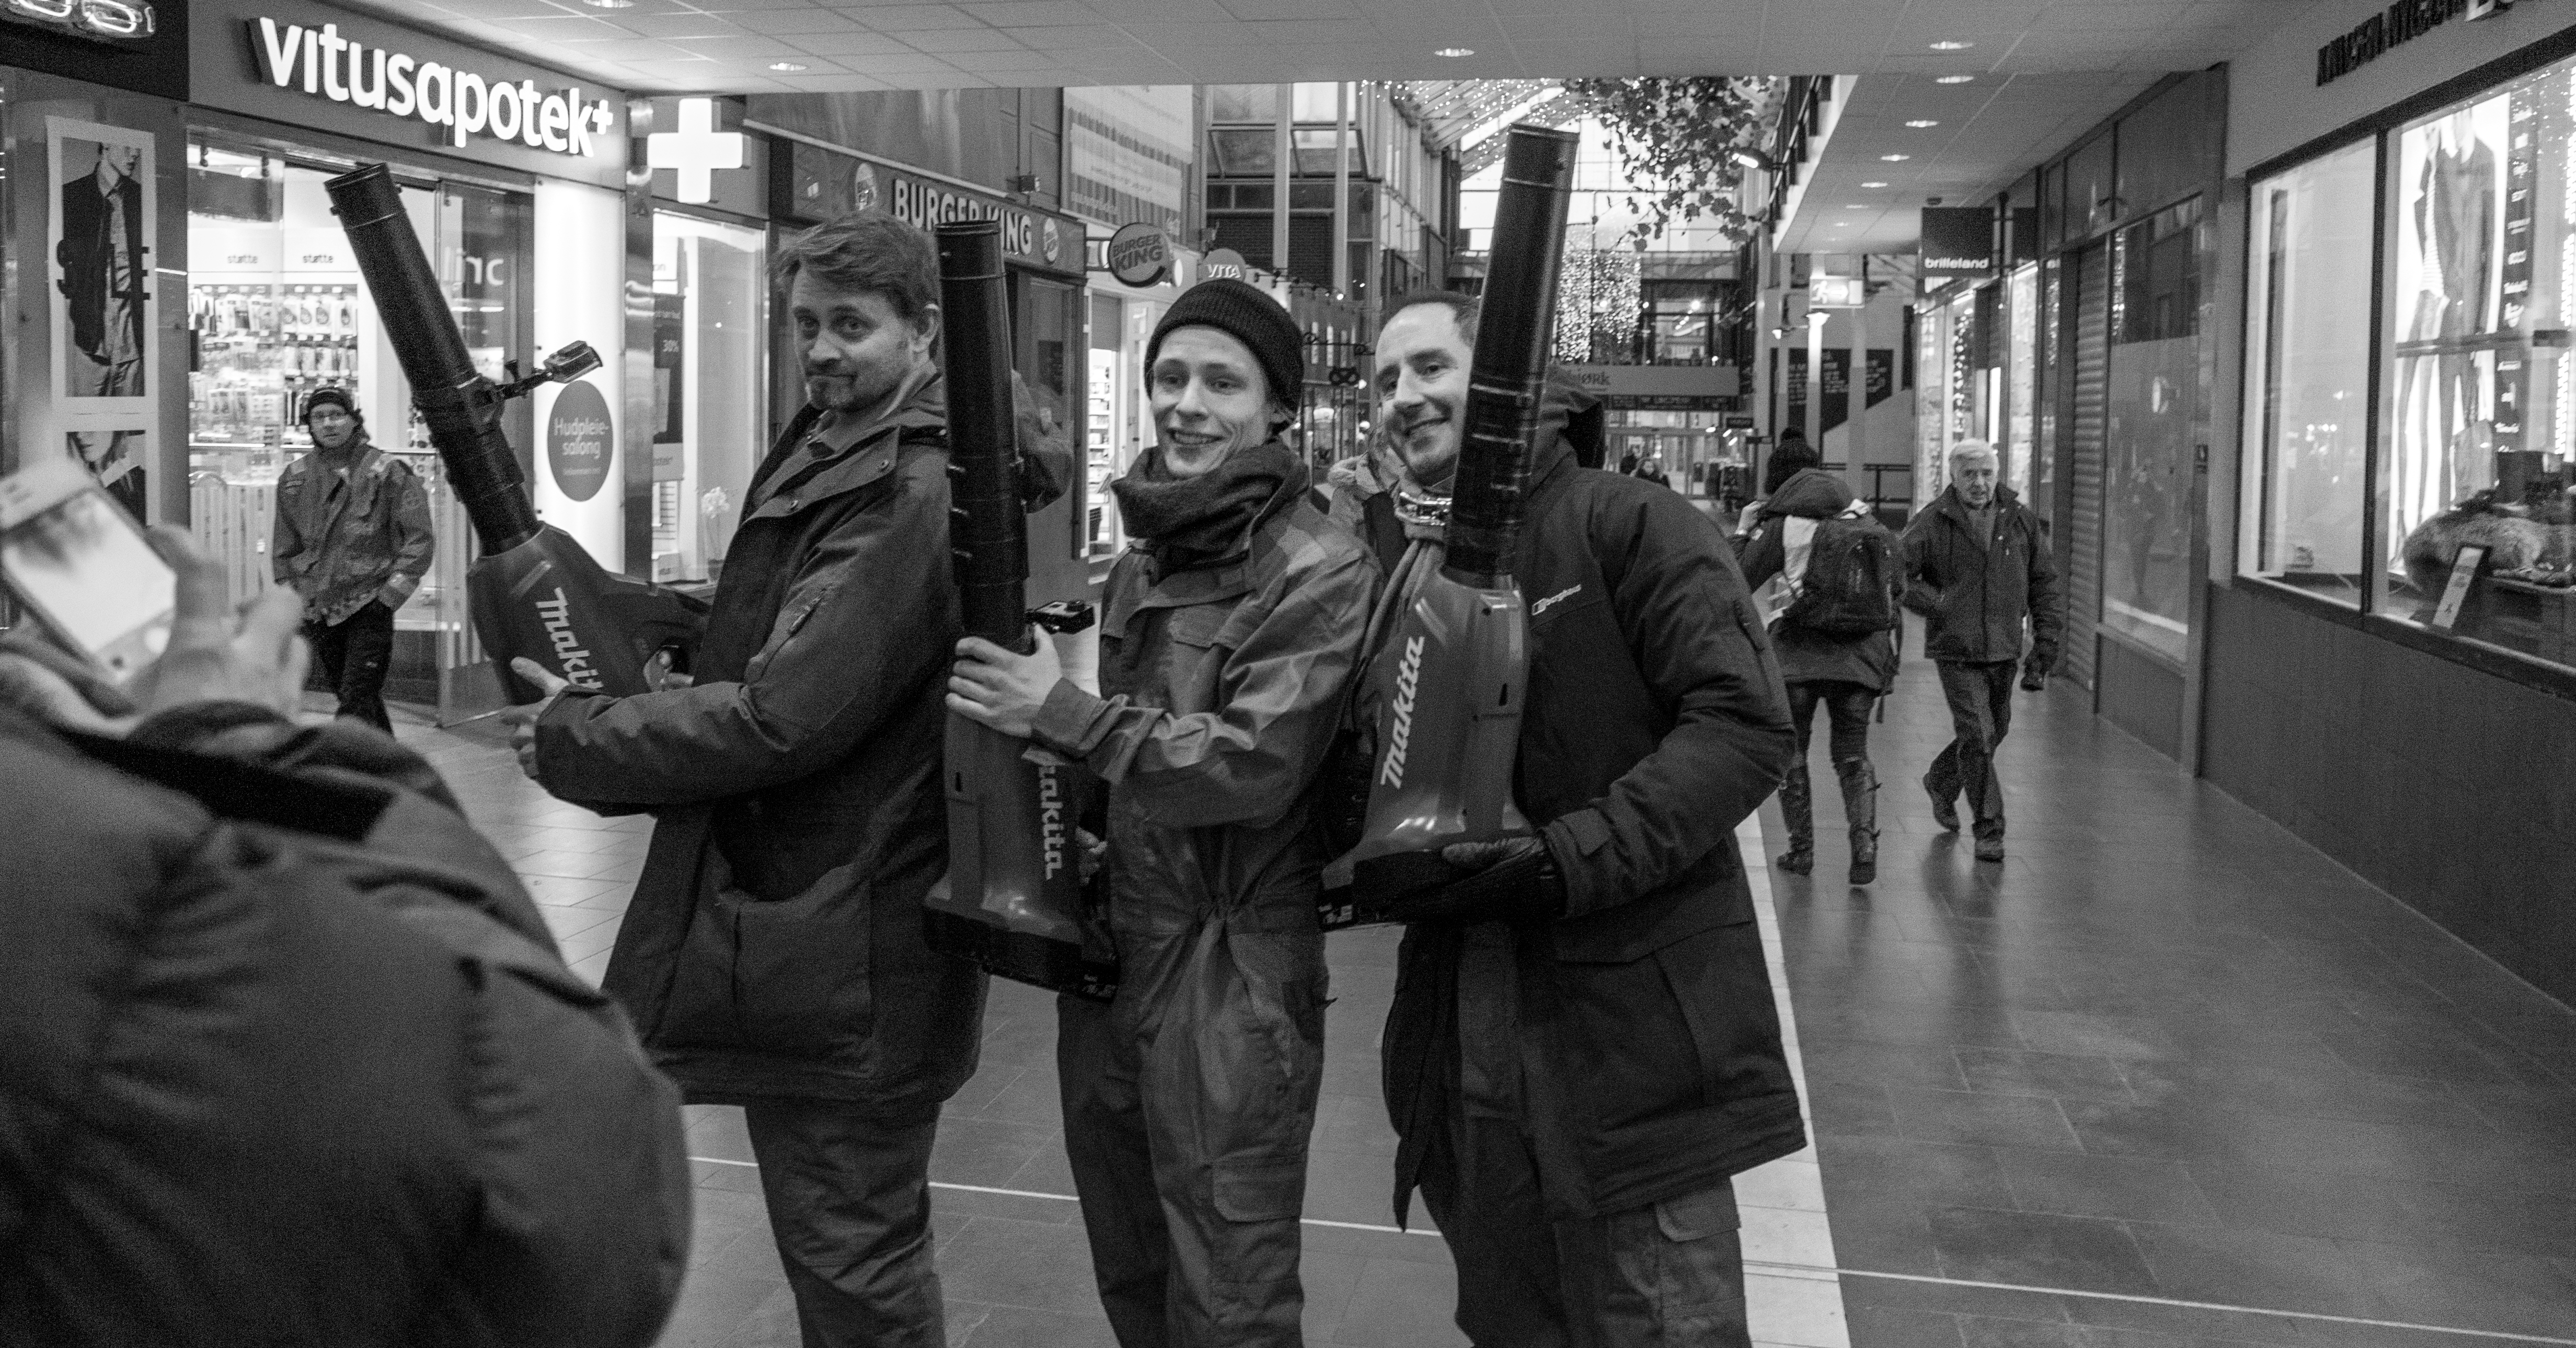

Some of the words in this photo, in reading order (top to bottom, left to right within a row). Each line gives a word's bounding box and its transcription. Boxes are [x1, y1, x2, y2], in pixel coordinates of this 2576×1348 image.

[1114, 244, 1163, 270] KING
[1925, 257, 1990, 269] brilleland
[562, 438, 601, 460] salong
[536, 586, 604, 689] makit
[1380, 636, 1425, 790] makita
